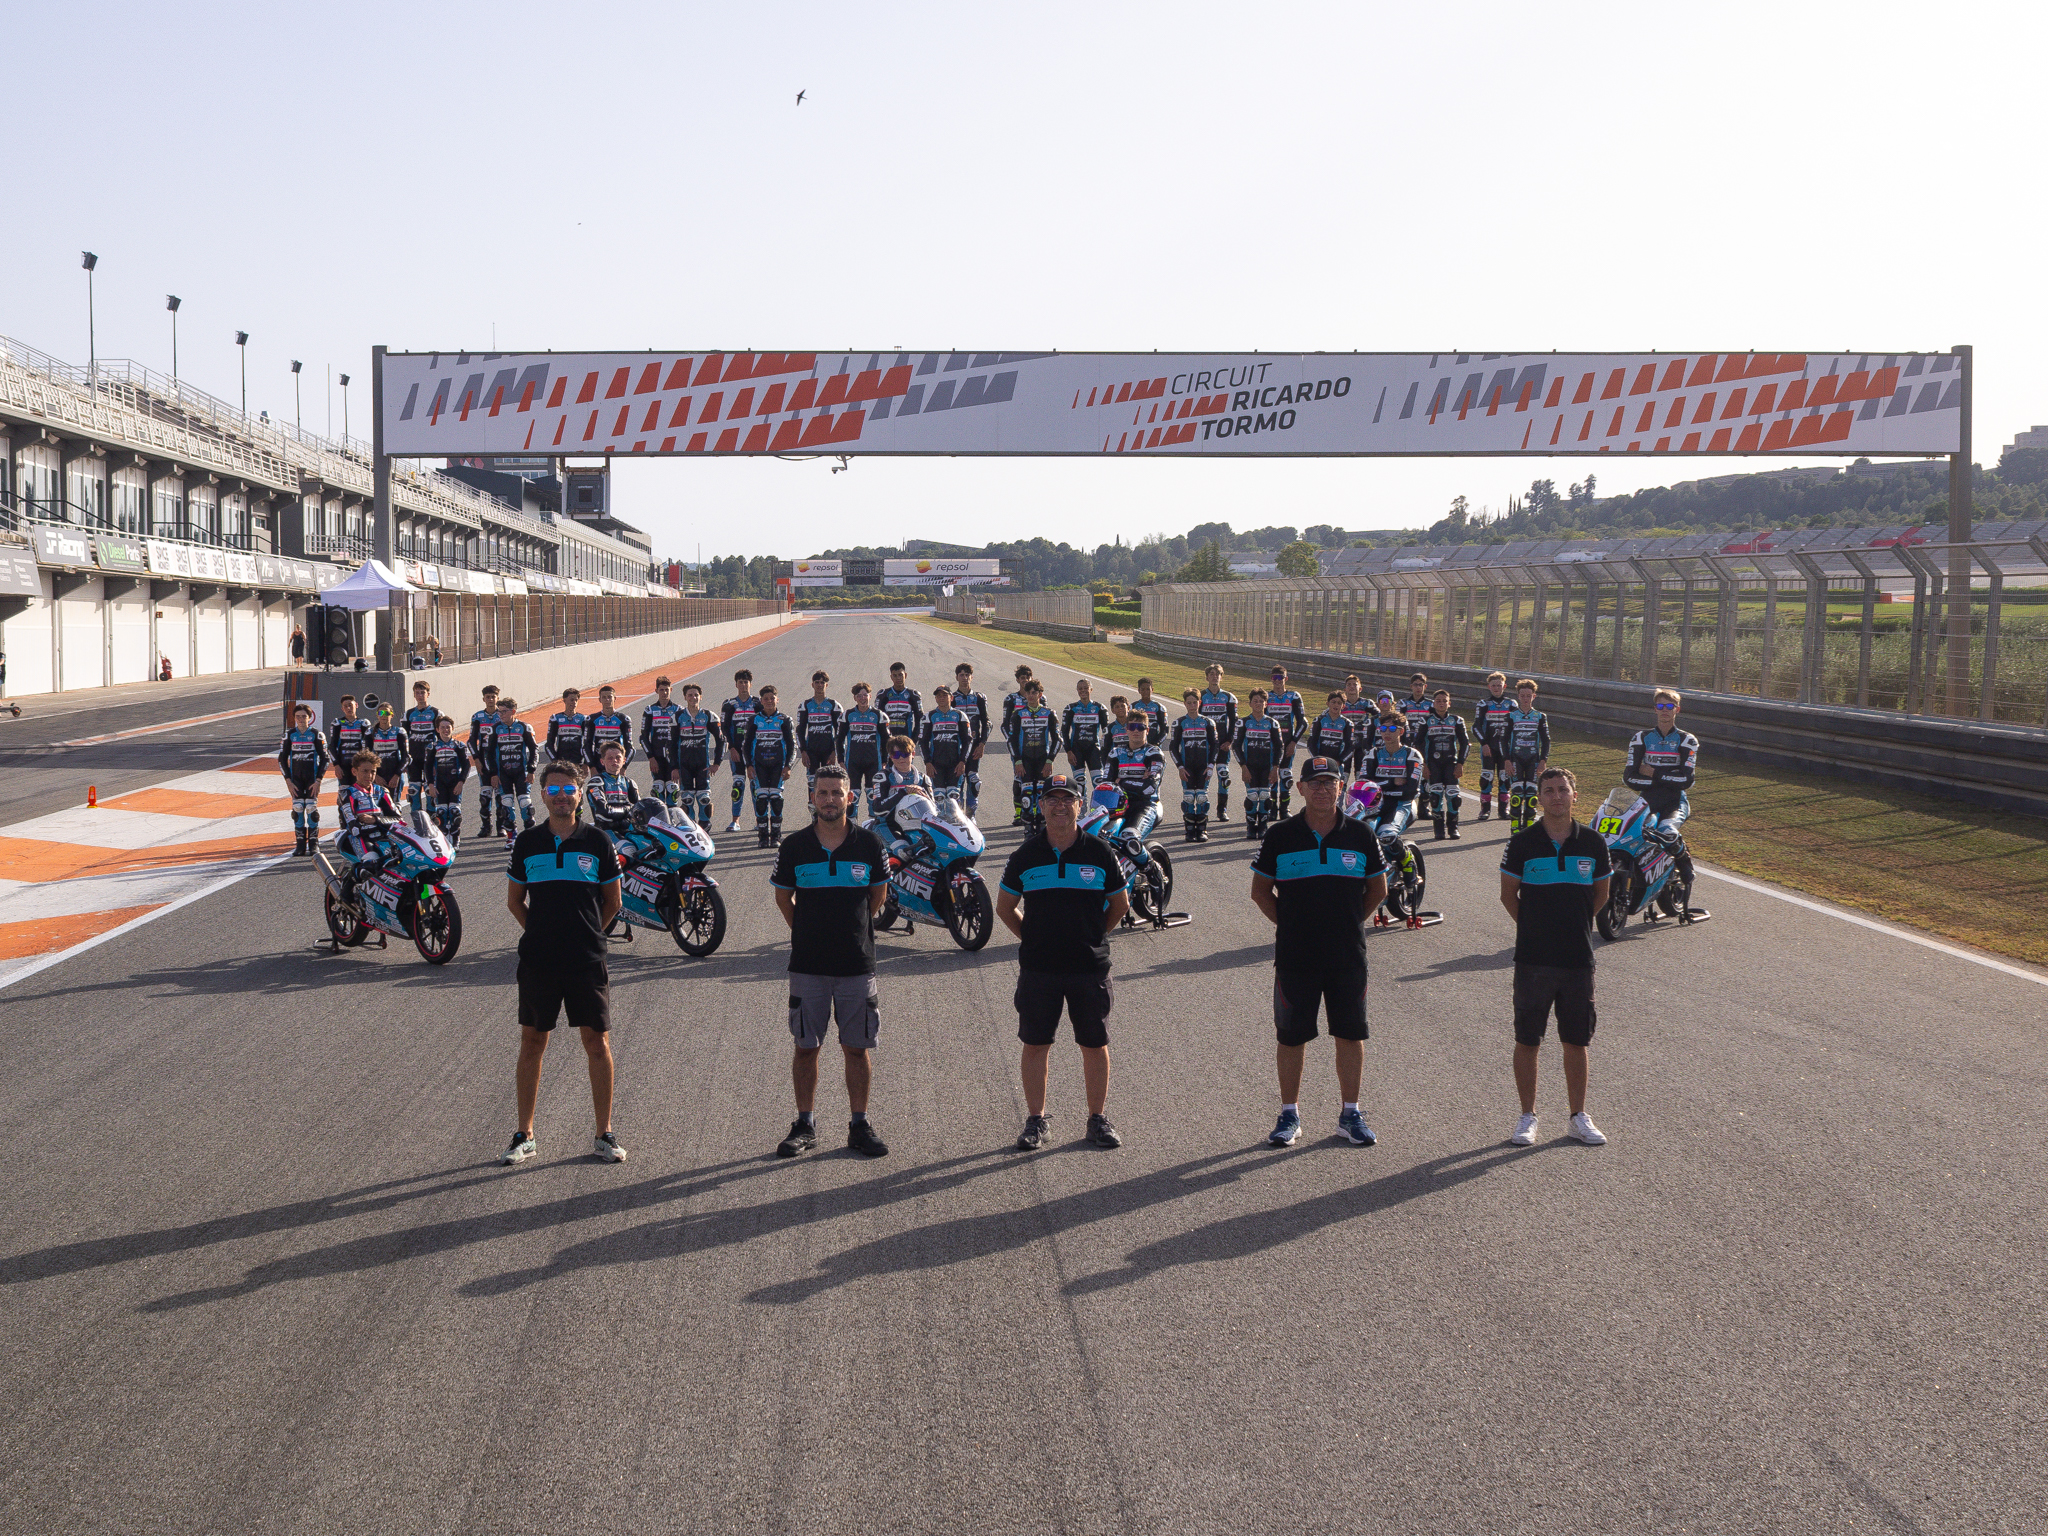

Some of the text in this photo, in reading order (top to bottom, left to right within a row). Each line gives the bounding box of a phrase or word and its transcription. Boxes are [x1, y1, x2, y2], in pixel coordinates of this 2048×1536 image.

[1171, 363, 1272, 395] CIRCUIT
[1231, 377, 1351, 412] RICARDO
[1201, 409, 1296, 441] TORMO
[813, 564, 838, 572] repsol
[936, 563, 969, 572] repsol
[685, 832, 709, 848] 24
[1599, 817, 1621, 834] 87
[428, 839, 442, 853] 6
[361, 879, 399, 912] MIR
[620, 873, 659, 904] MIR
[893, 871, 932, 901] MIR
